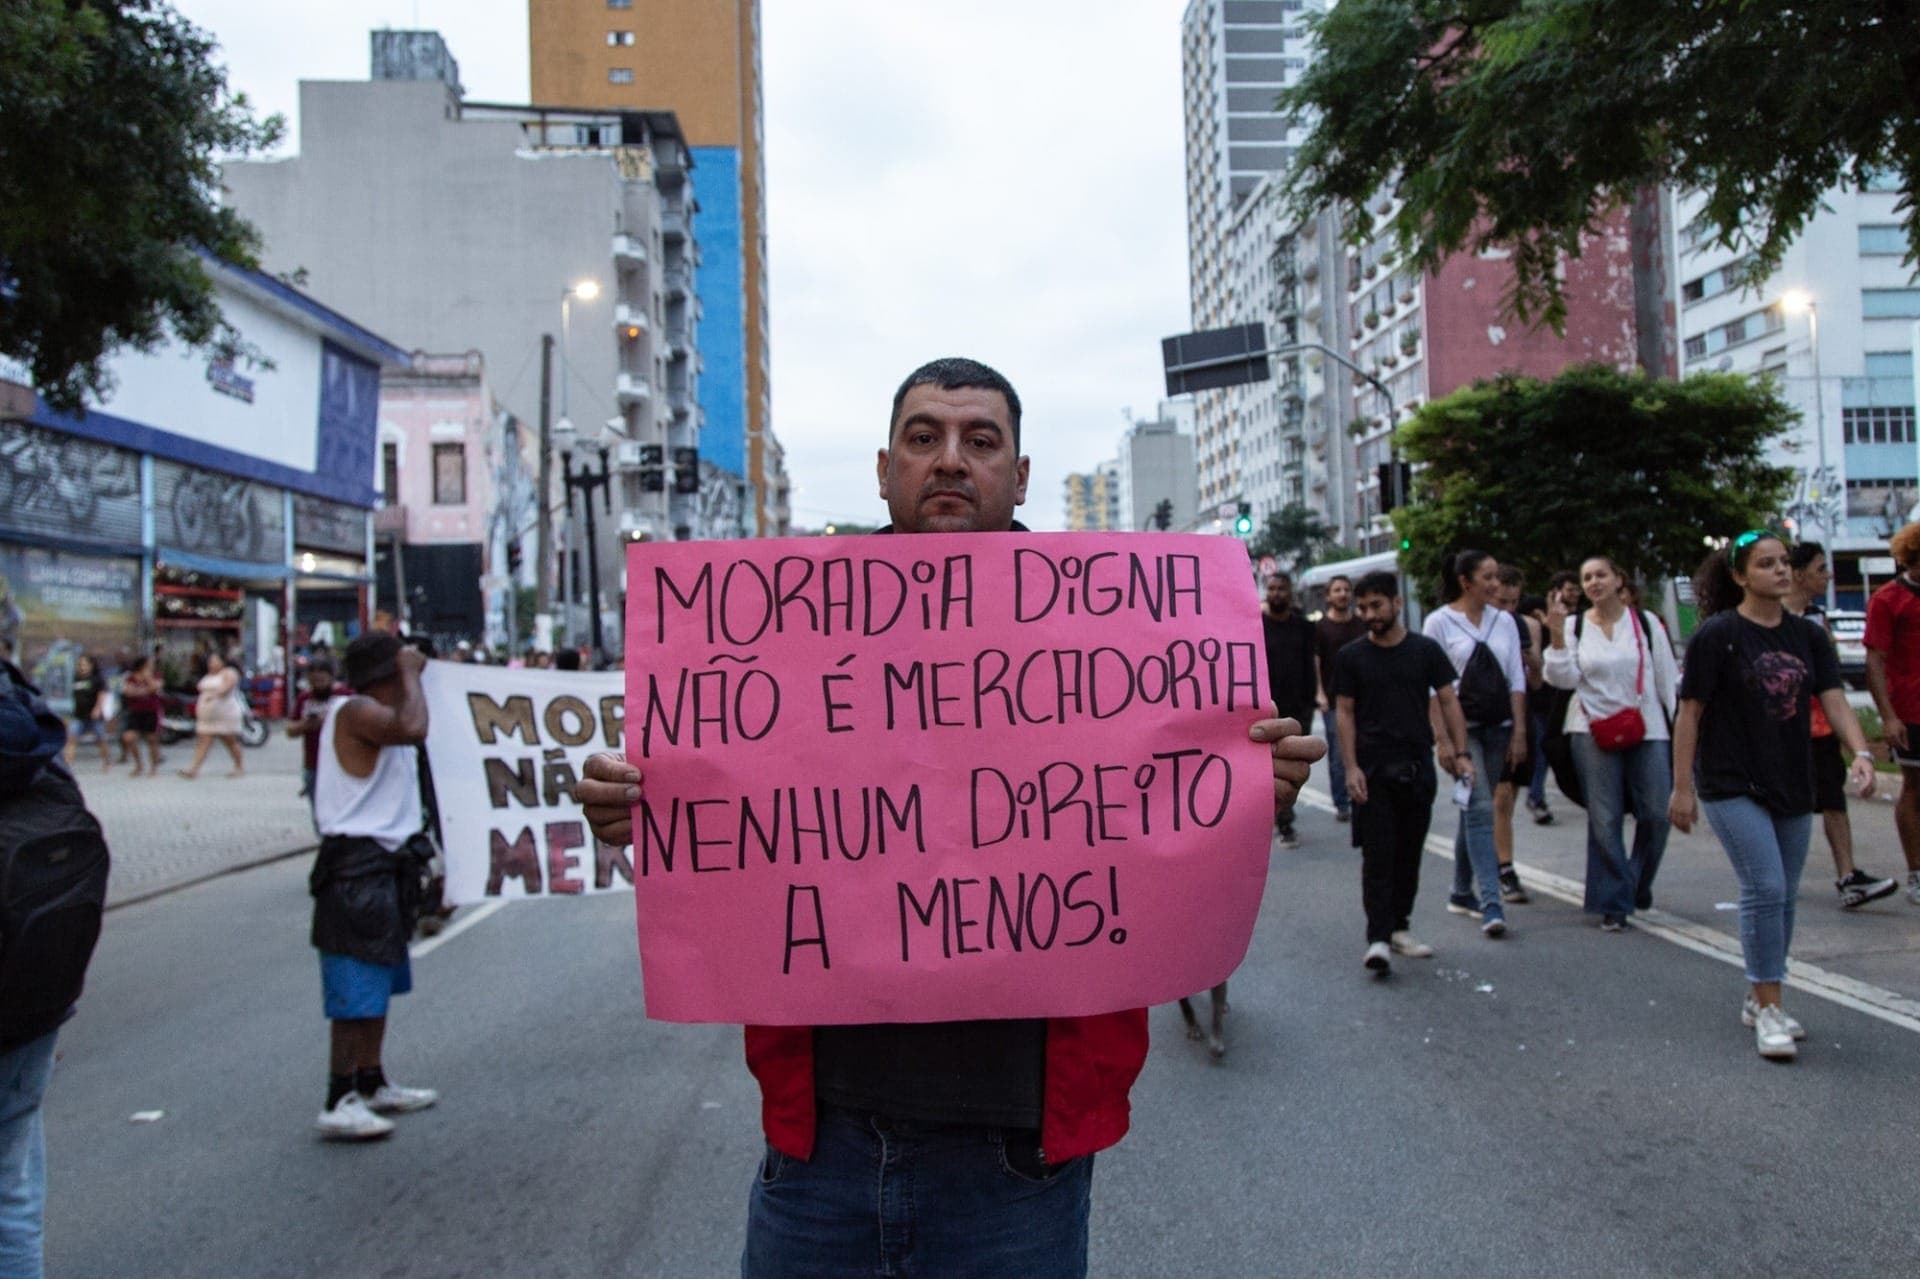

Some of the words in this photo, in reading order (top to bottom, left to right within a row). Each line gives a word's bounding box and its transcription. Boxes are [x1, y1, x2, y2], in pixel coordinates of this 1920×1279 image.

[641, 653, 781, 757] NÃO
[821, 653, 857, 734] É
[641, 783, 926, 876] NENHUM
[782, 883, 831, 975] A
[896, 865, 1127, 962] MENOS!
